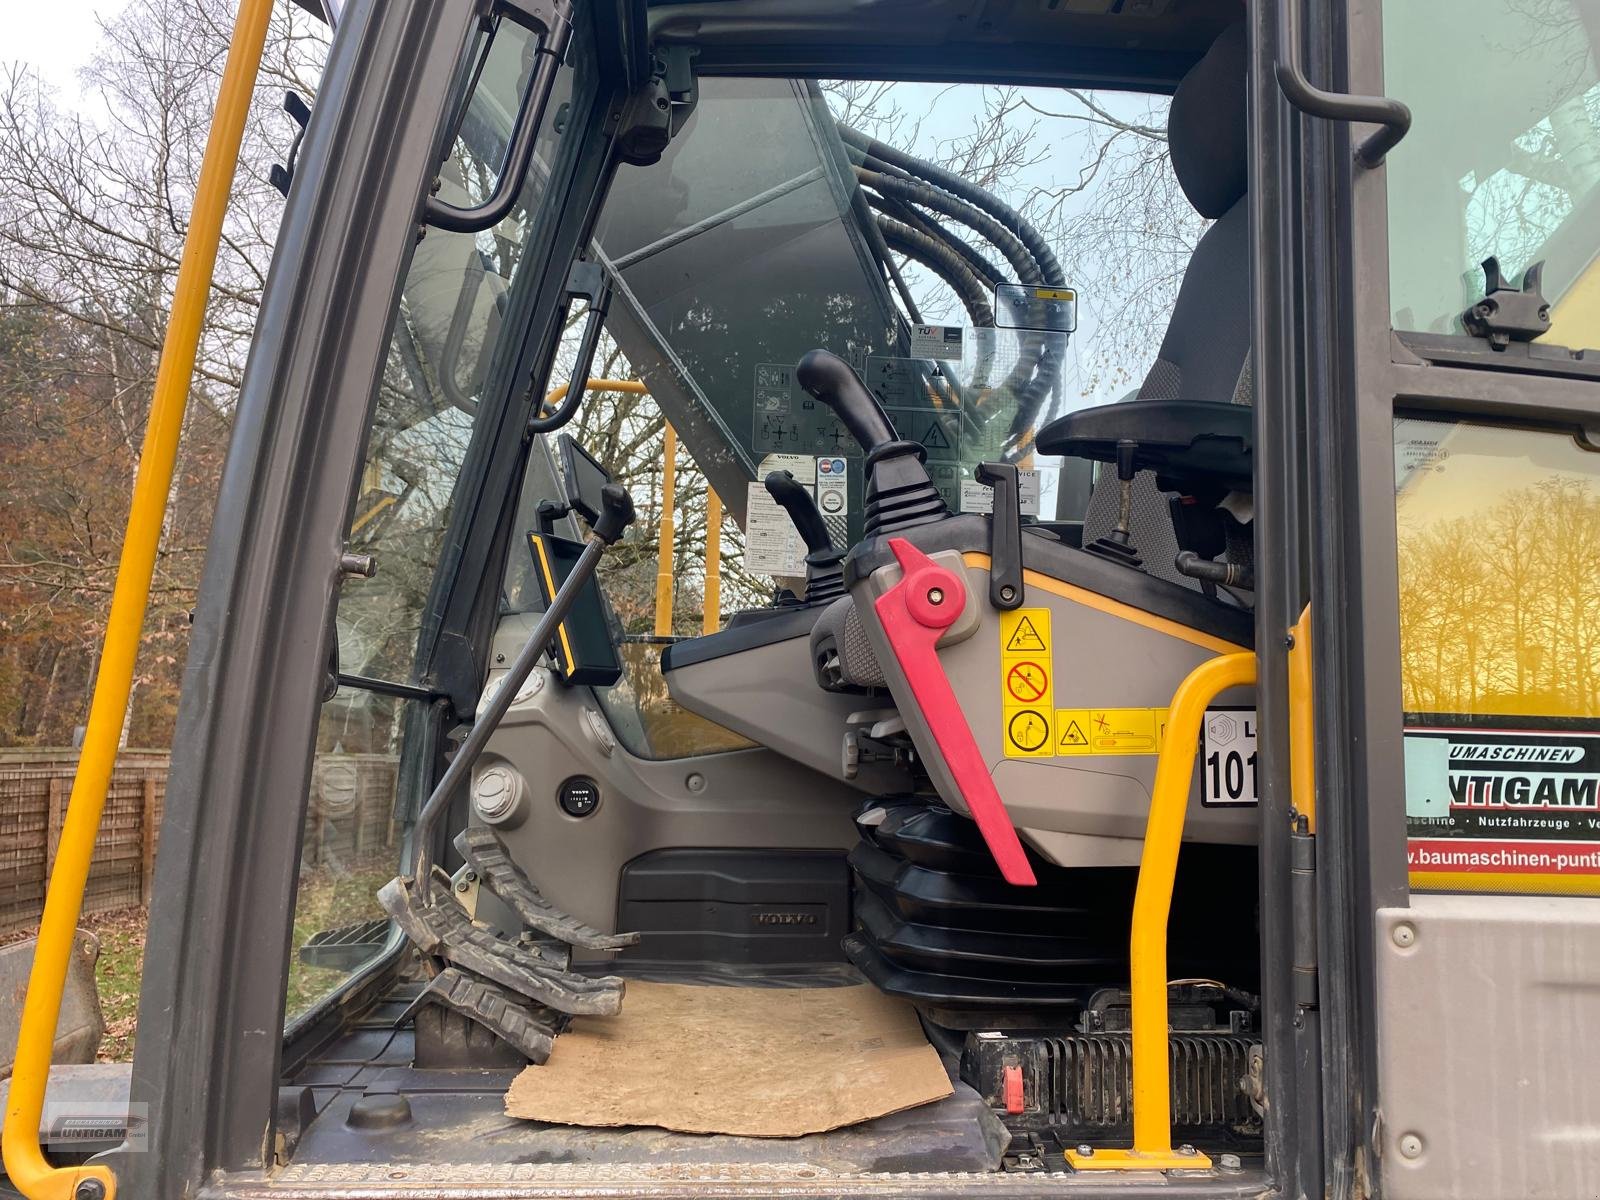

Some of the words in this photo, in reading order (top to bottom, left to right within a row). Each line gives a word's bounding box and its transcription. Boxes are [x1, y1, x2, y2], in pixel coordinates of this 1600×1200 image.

[918, 326, 937, 335] TÜV
[1449, 746, 1575, 761] UMASCHINEN
[1449, 775, 1598, 806] NTIGAM
[1478, 816, 1570, 830] Nutzfahrzeuge
